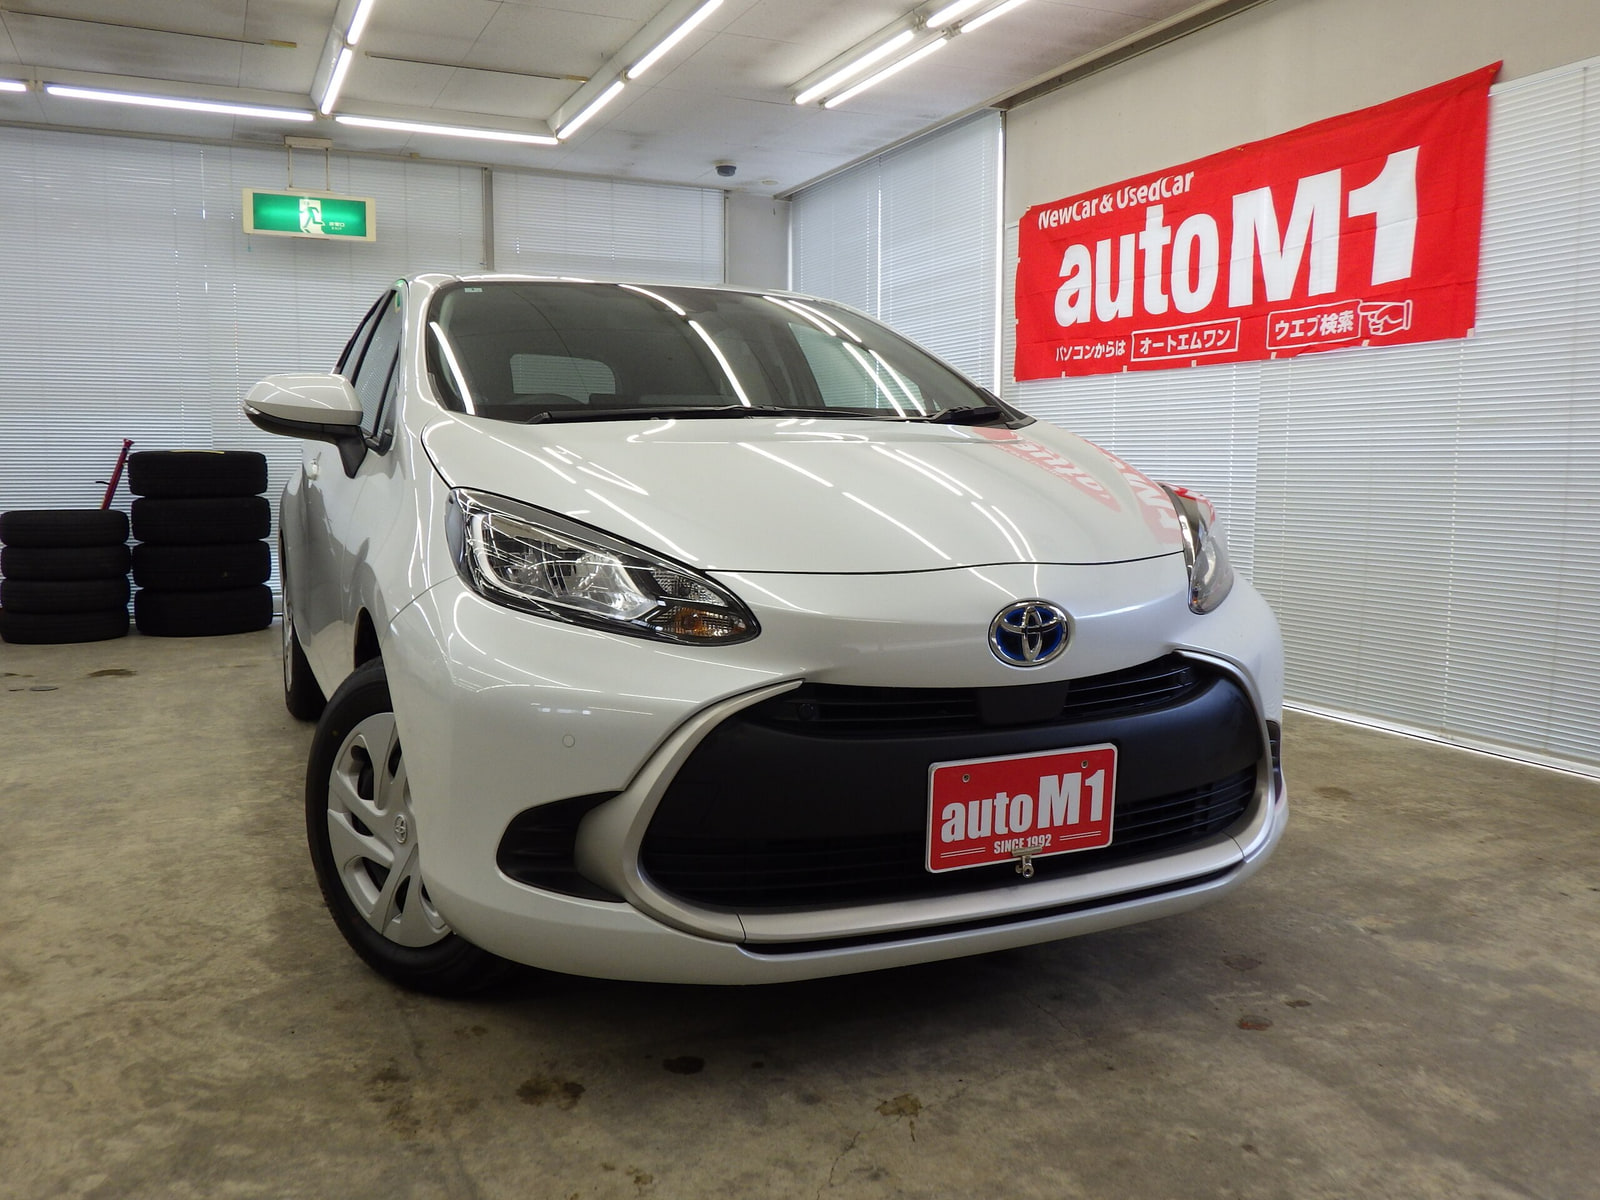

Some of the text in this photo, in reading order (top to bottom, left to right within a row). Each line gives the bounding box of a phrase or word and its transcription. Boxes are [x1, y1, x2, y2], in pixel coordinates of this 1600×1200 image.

[1116, 171, 1195, 209] UsedCar
[1275, 310, 1354, 341] ウエブ検索
[1055, 339, 1126, 361] パソコンからは
[1139, 330, 1231, 355] オートエムワン
[993, 834, 1052, 854] SINCE 1992
